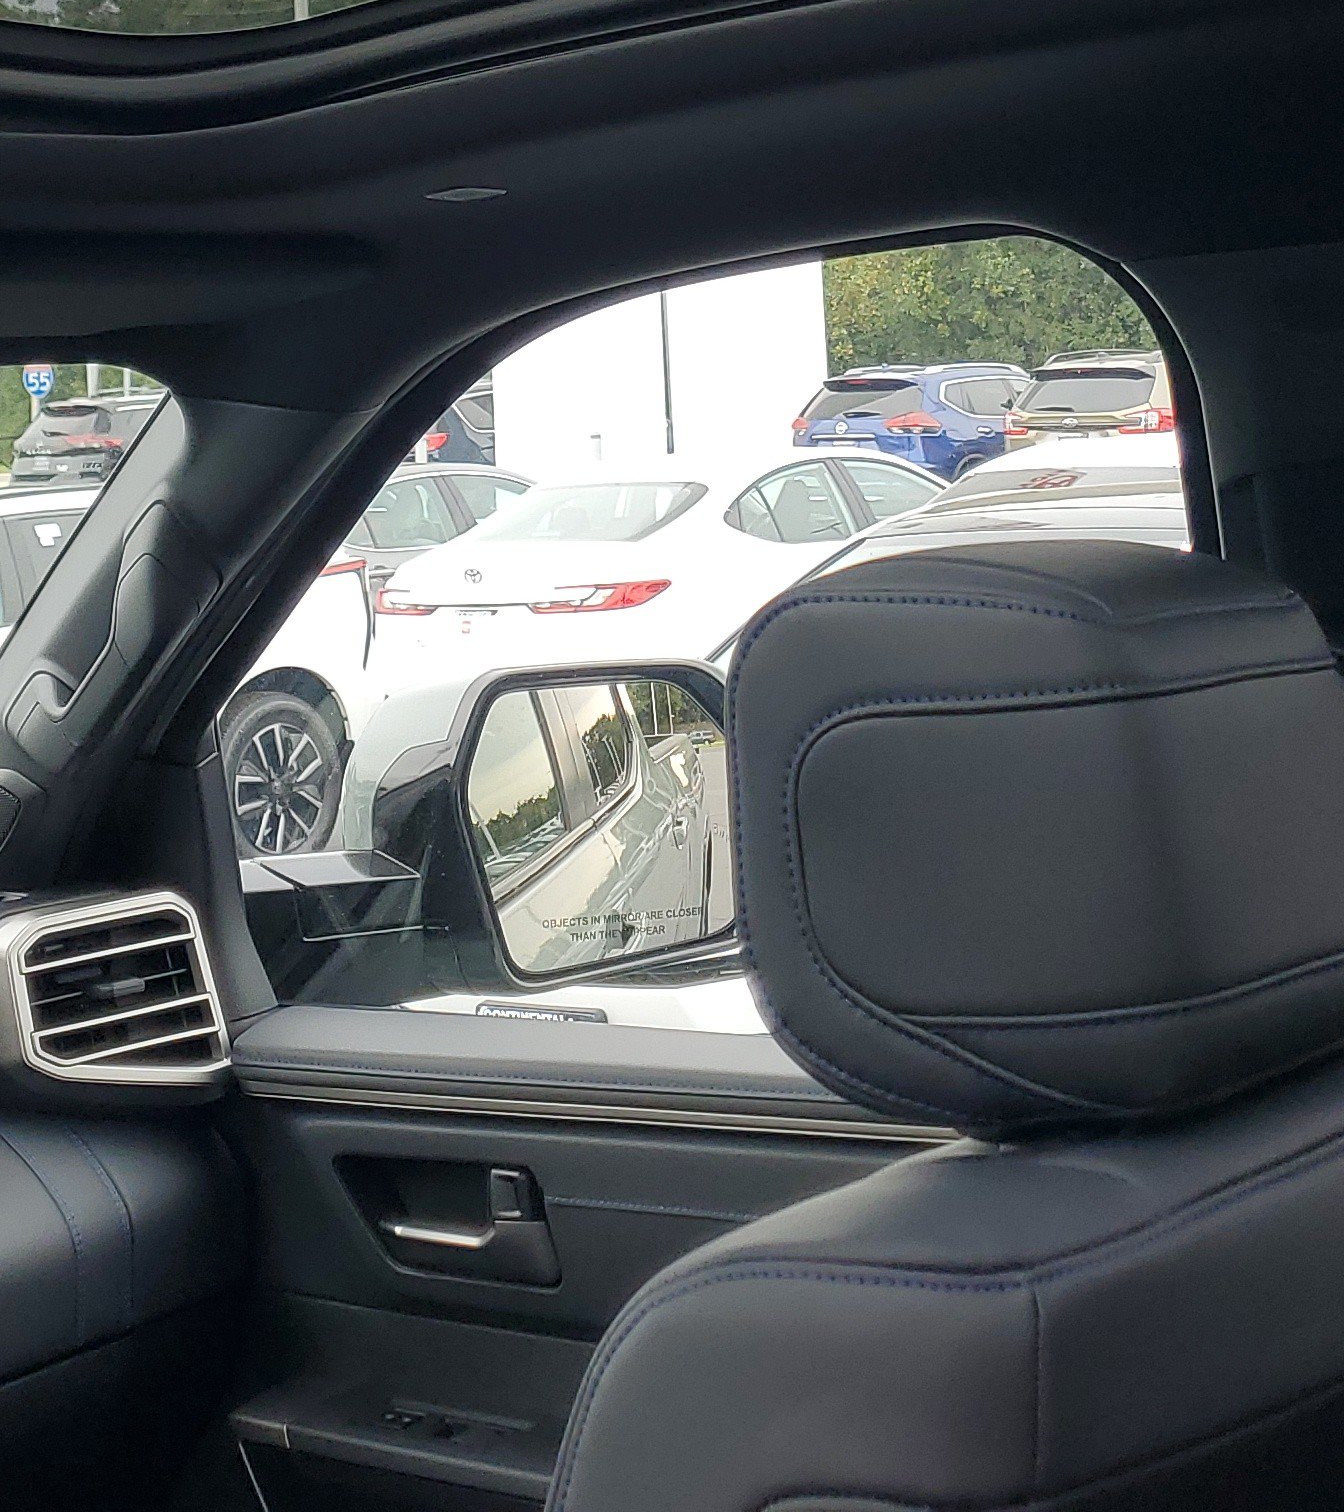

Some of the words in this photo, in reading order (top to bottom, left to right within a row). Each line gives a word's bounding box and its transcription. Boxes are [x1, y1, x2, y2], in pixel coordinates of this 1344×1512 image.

[30, 372, 51, 390] 55
[542, 917, 589, 929] OBJECTS
[591, 915, 601, 925] IN
[603, 912, 642, 924] MIRROR
[645, 910, 664, 920] ARE
[570, 931, 596, 942] THAN
